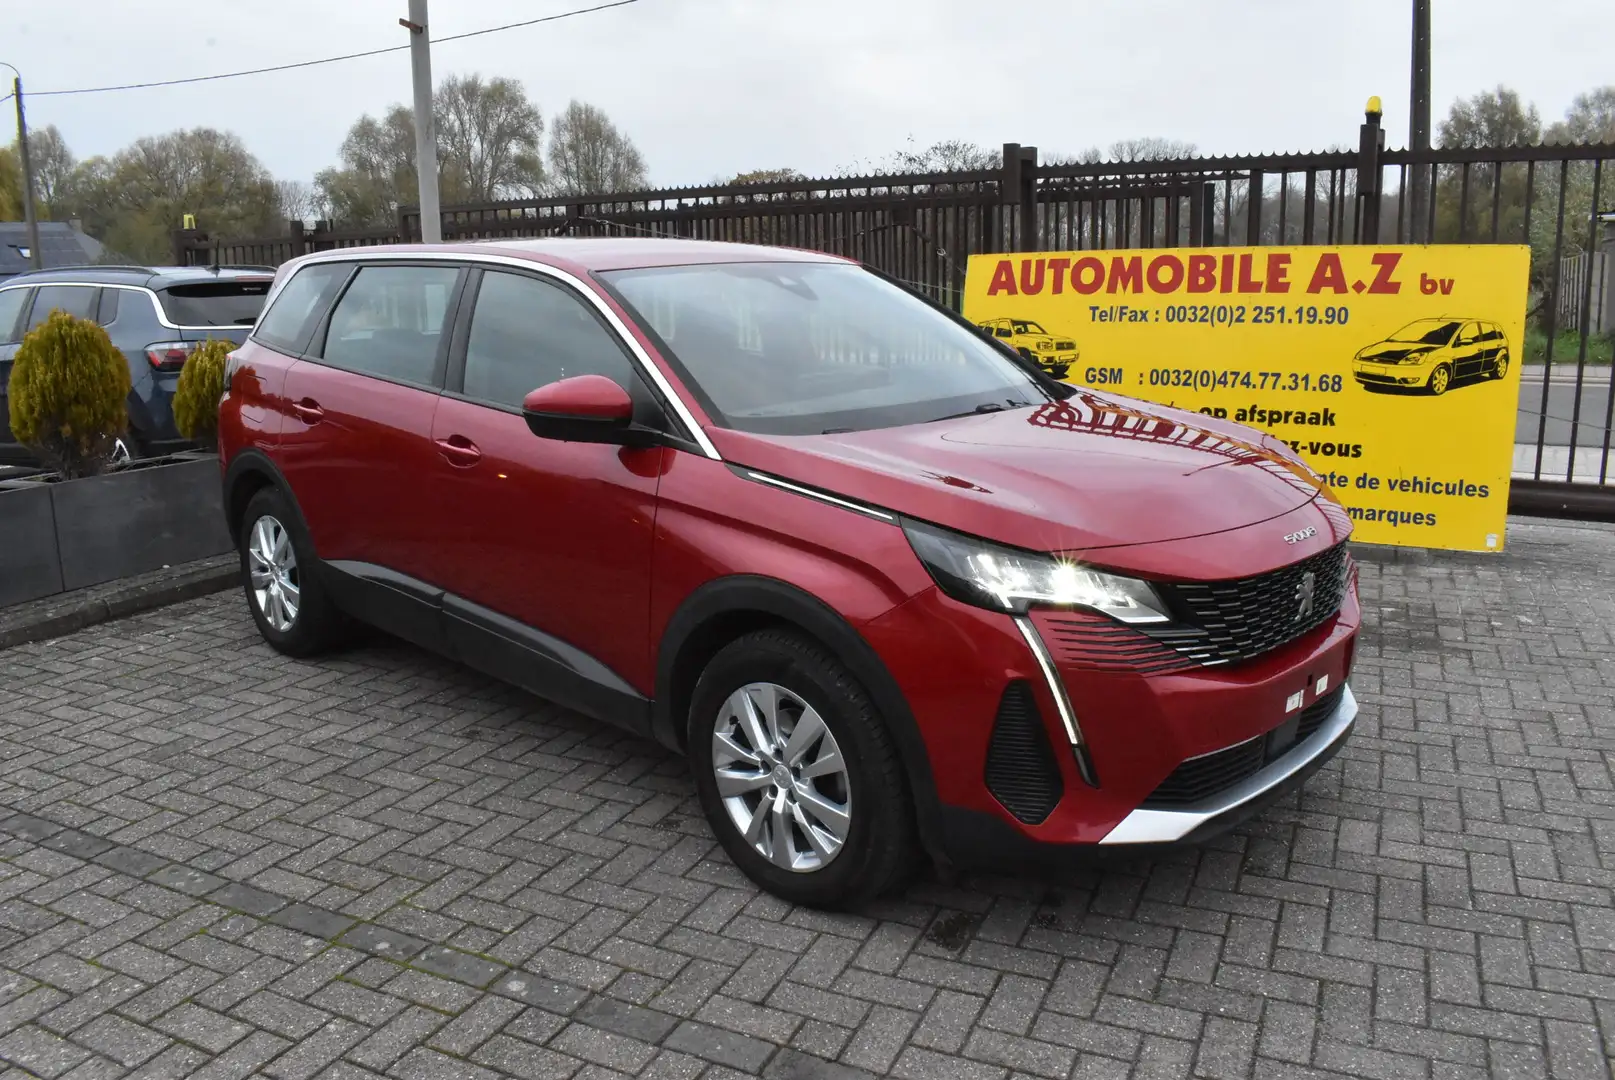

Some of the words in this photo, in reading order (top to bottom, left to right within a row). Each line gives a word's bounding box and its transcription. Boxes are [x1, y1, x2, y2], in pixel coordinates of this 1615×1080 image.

[987, 253, 1292, 296] AUTOMOBILE
[1306, 253, 1403, 295] A.Z
[1419, 272, 1455, 296] bv
[1089, 305, 1149, 323] Tel/Fax
[1165, 305, 1246, 328] 0032(0)2
[1252, 306, 1349, 325] 251.19.90
[1084, 367, 1123, 385] GSM
[1149, 368, 1343, 393] 0032(0)474.77.31.68
[1234, 404, 1337, 428] afspraak
[1280, 439, 1362, 459] z-vous
[1355, 472, 1380, 490] de
[1387, 475, 1490, 499] vehicules
[1347, 506, 1437, 528] marques
[1283, 526, 1318, 545] 5008
